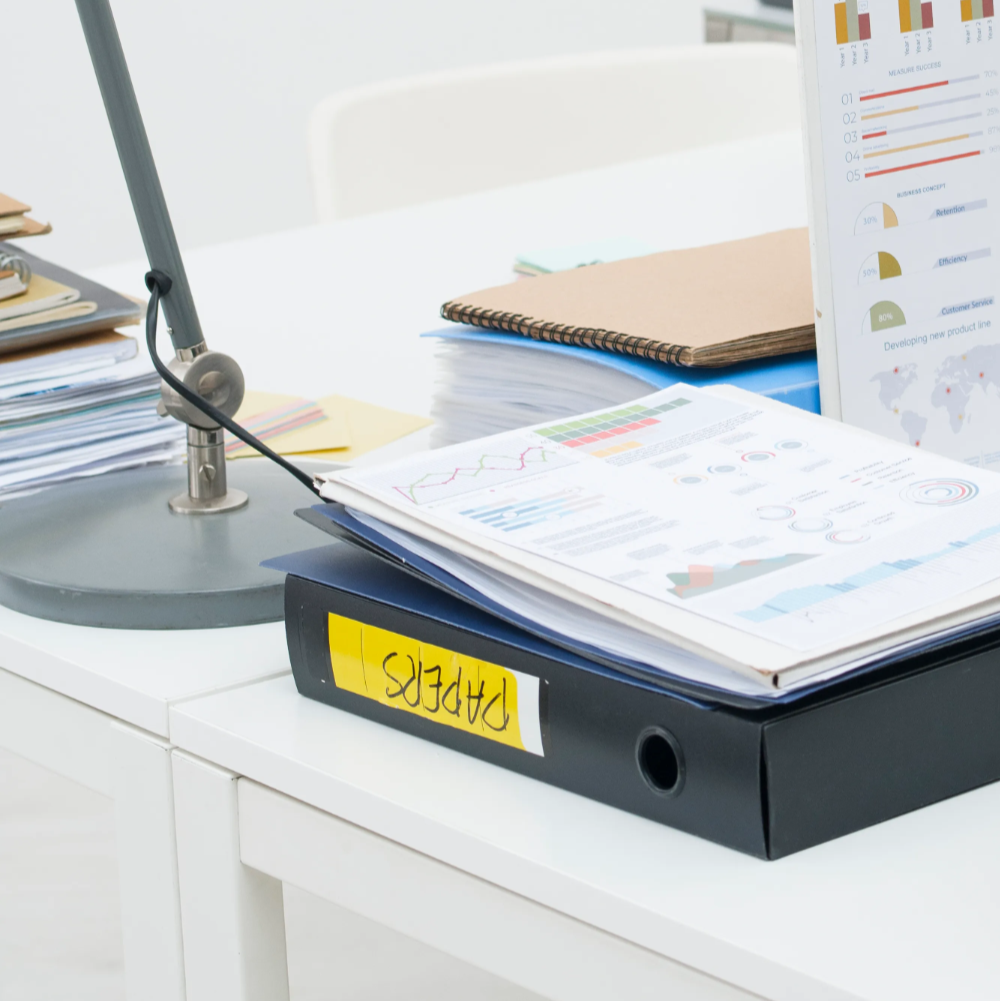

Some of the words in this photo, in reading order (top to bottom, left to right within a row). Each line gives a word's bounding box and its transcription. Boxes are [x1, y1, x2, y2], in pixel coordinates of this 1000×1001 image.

[888, 66, 915, 77] MEASURE
[916, 61, 942, 72] SUCCESS
[842, 92, 853, 106] 01
[842, 112, 857, 125] 02
[844, 131, 858, 144] 03
[845, 150, 860, 164] 04
[846, 169, 860, 182] 05
[896, 188, 922, 198] BUSINESS
[922, 183, 946, 193] CONCEPT
[936, 205, 966, 217] Retention
[863, 216, 878, 226] 30%
[938, 254, 968, 267] Efficiency
[862, 268, 878, 278] 50%
[942, 303, 970, 316] Customer
[972, 298, 994, 309] Service
[878, 312, 894, 323] 80%
[884, 334, 928, 352] Developing
[929, 332, 946, 341] new
[948, 323, 976, 338] product
[978, 320, 992, 329] line
[382, 651, 510, 732] PAPERS
